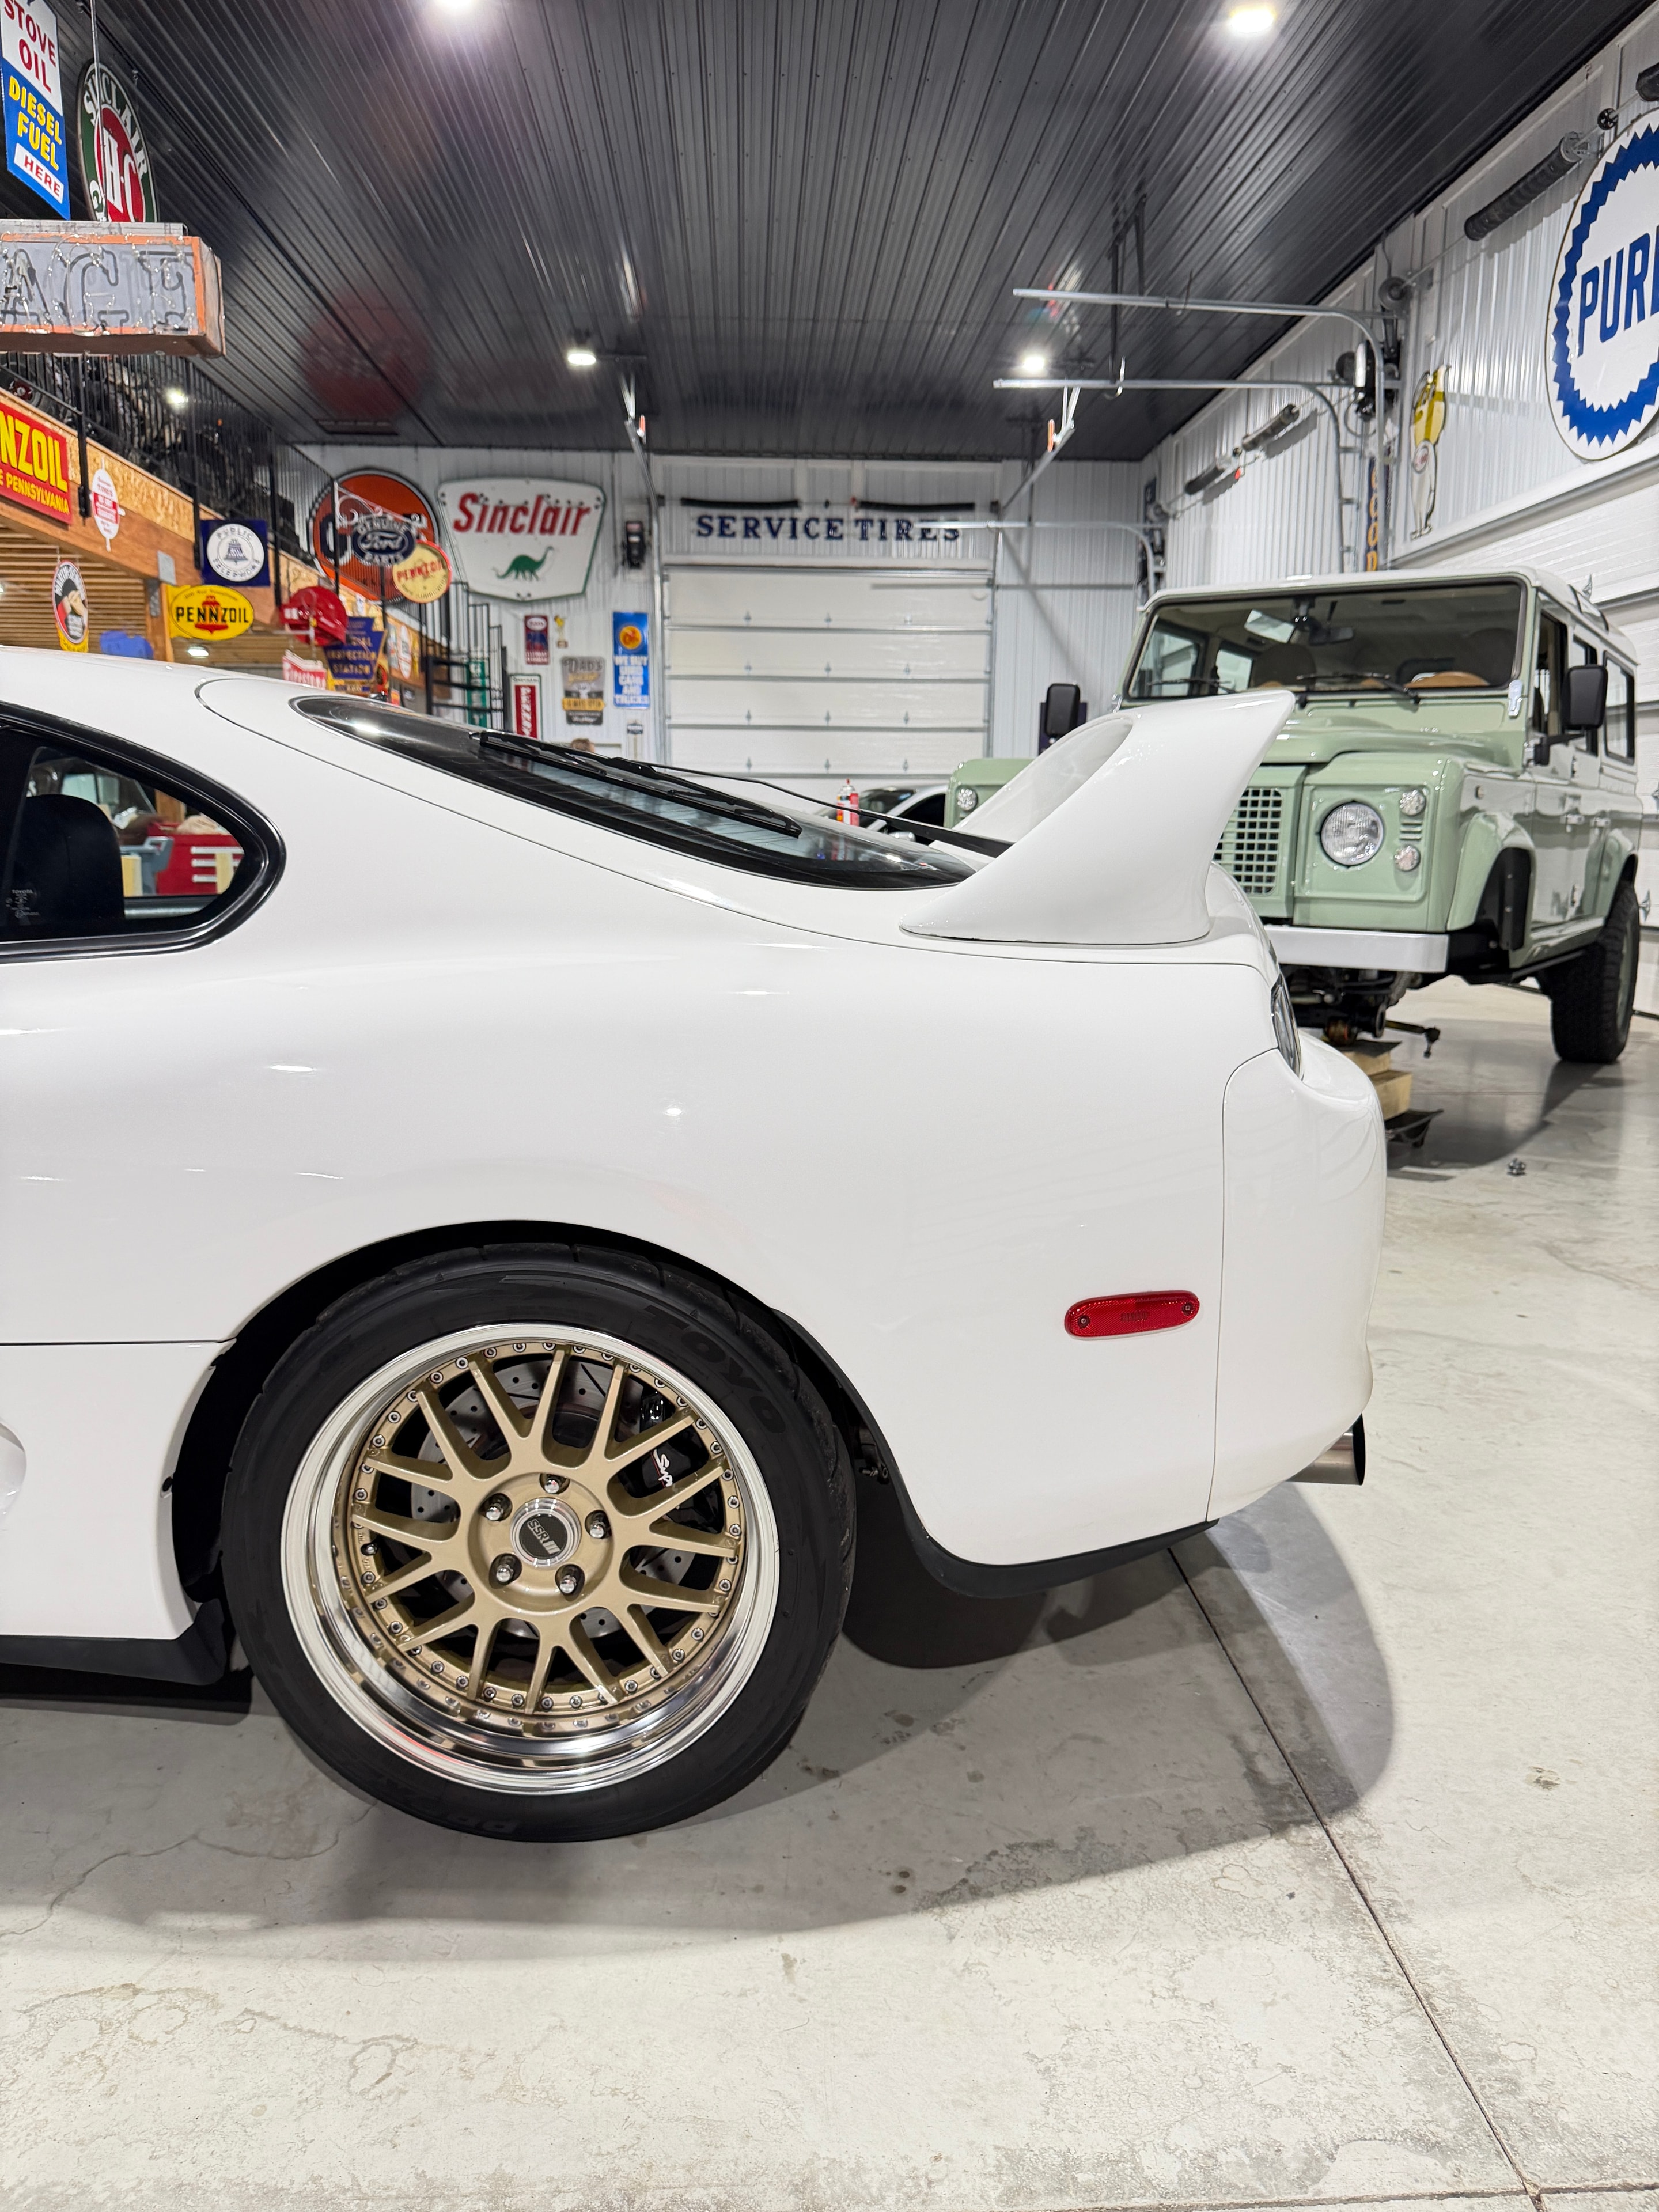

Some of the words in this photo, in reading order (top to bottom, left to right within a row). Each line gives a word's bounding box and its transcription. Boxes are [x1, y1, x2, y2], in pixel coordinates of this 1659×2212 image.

[4, 0, 56, 68] STOVE
[18, 39, 52, 94] OIL
[9, 75, 62, 145] DIESEL
[17, 111, 59, 171] FUEL
[24, 154, 60, 197] HERE
[1578, 225, 1659, 358] PUR
[6, 472, 70, 515] PENNSYLVANIA
[453, 493, 591, 536] Sinclair
[215, 526, 253, 540] PUBLIC
[361, 532, 403, 550] Ford
[696, 514, 843, 540] SERVICE
[854, 517, 960, 541] TIRES
[175, 606, 249, 623] PENNZOIL
[527, 1518, 550, 1544] SSR
